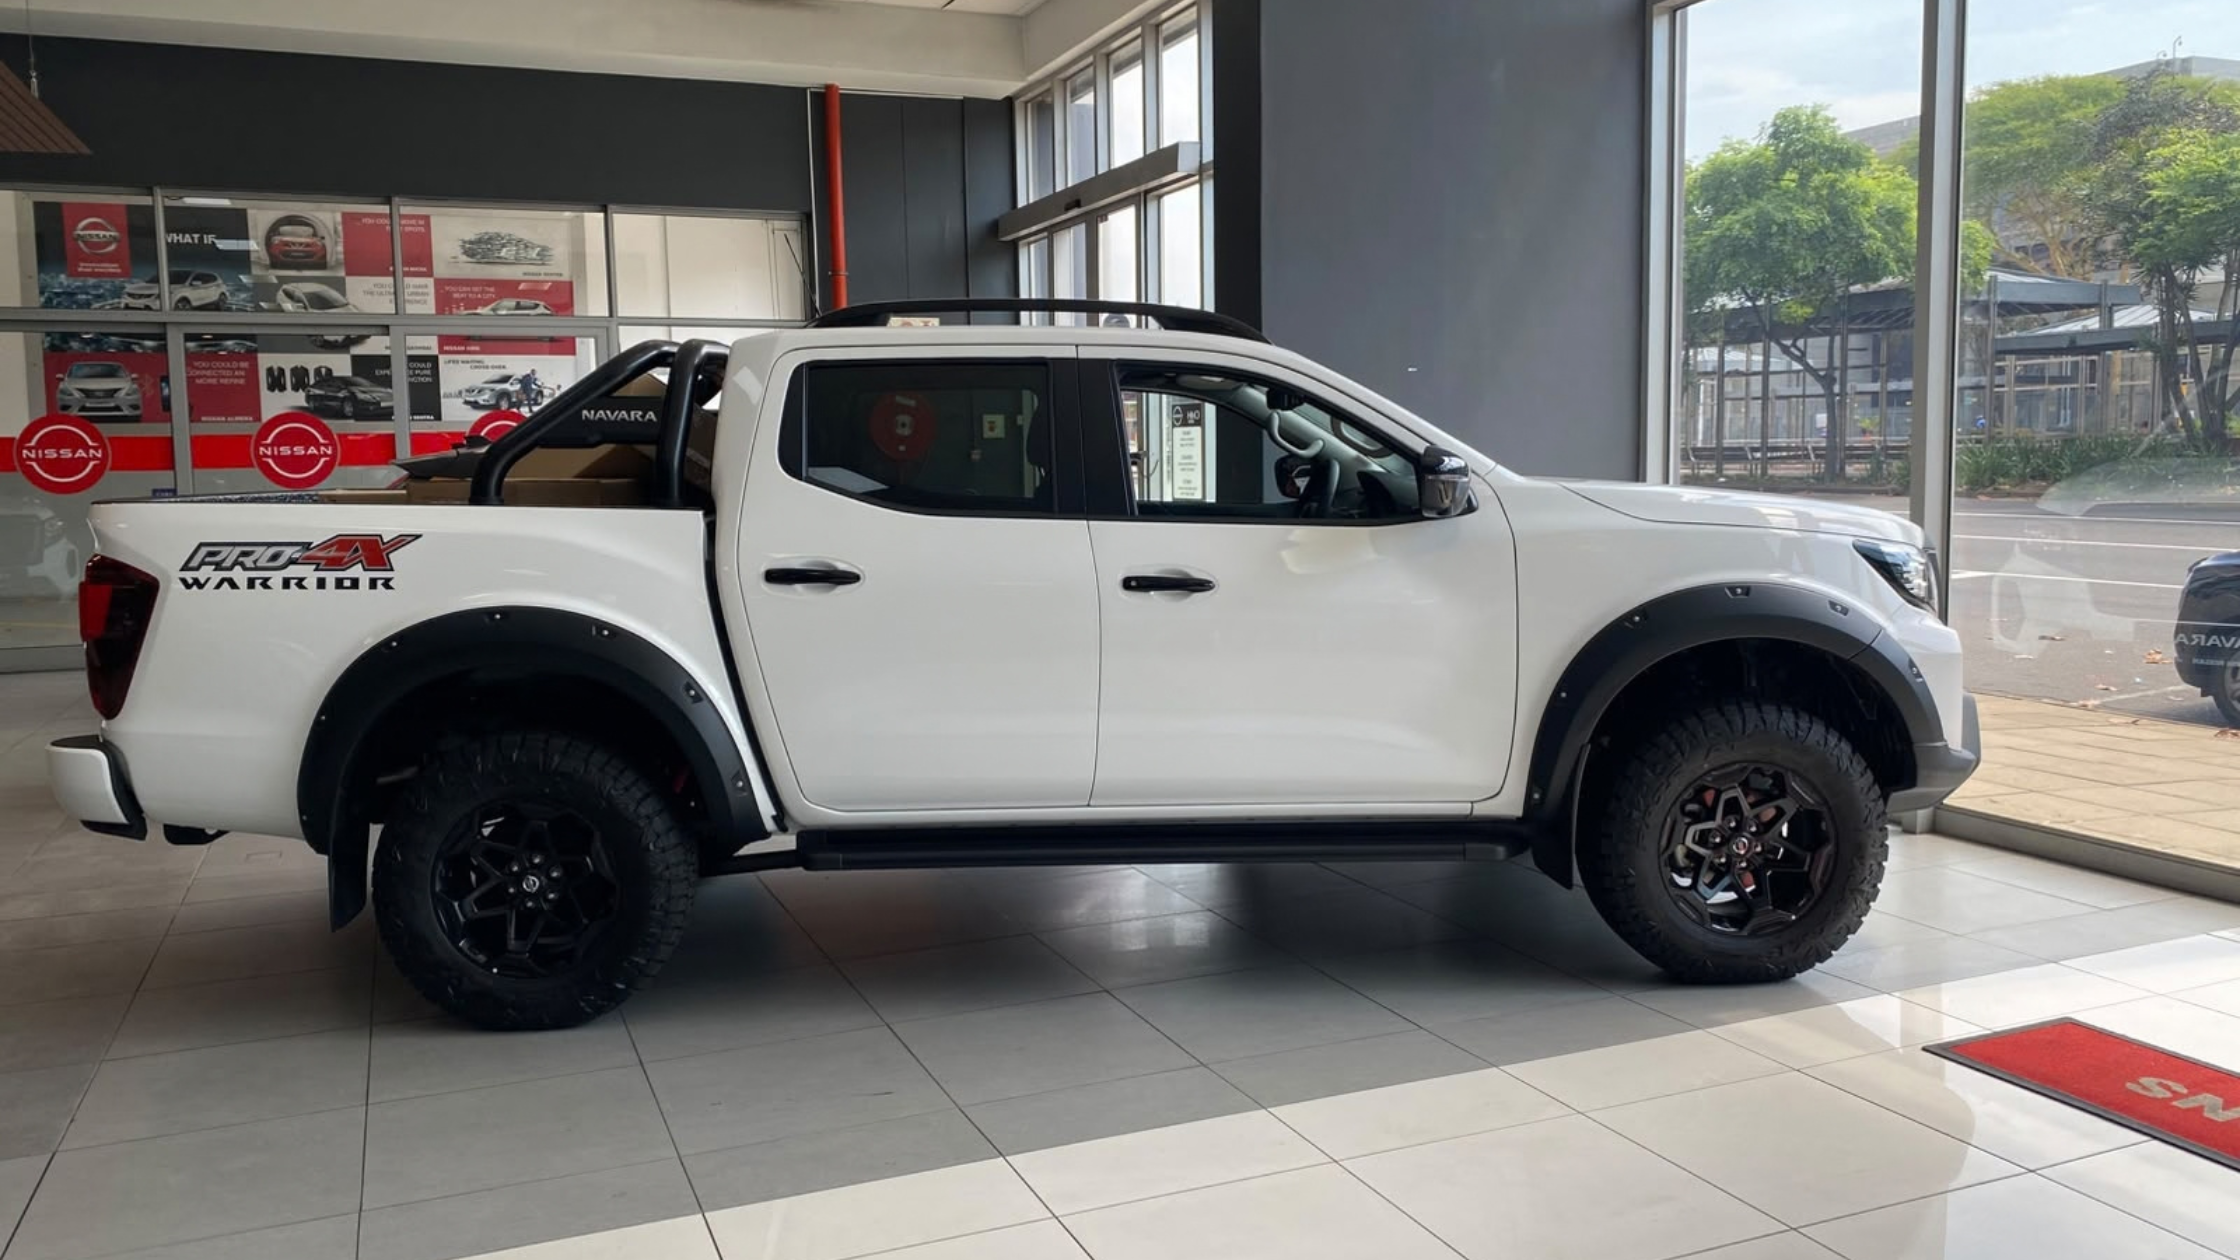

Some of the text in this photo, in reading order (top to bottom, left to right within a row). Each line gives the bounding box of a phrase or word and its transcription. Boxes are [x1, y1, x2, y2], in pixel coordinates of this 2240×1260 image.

[193, 360, 210, 369] YOU
[211, 360, 239, 369] COULD
[582, 409, 658, 422] NAVARA
[22, 448, 102, 459] NISSAN
[259, 446, 333, 456] NISSAN
[179, 534, 423, 572] PRO-4X
[178, 577, 396, 591] WARRIOR
